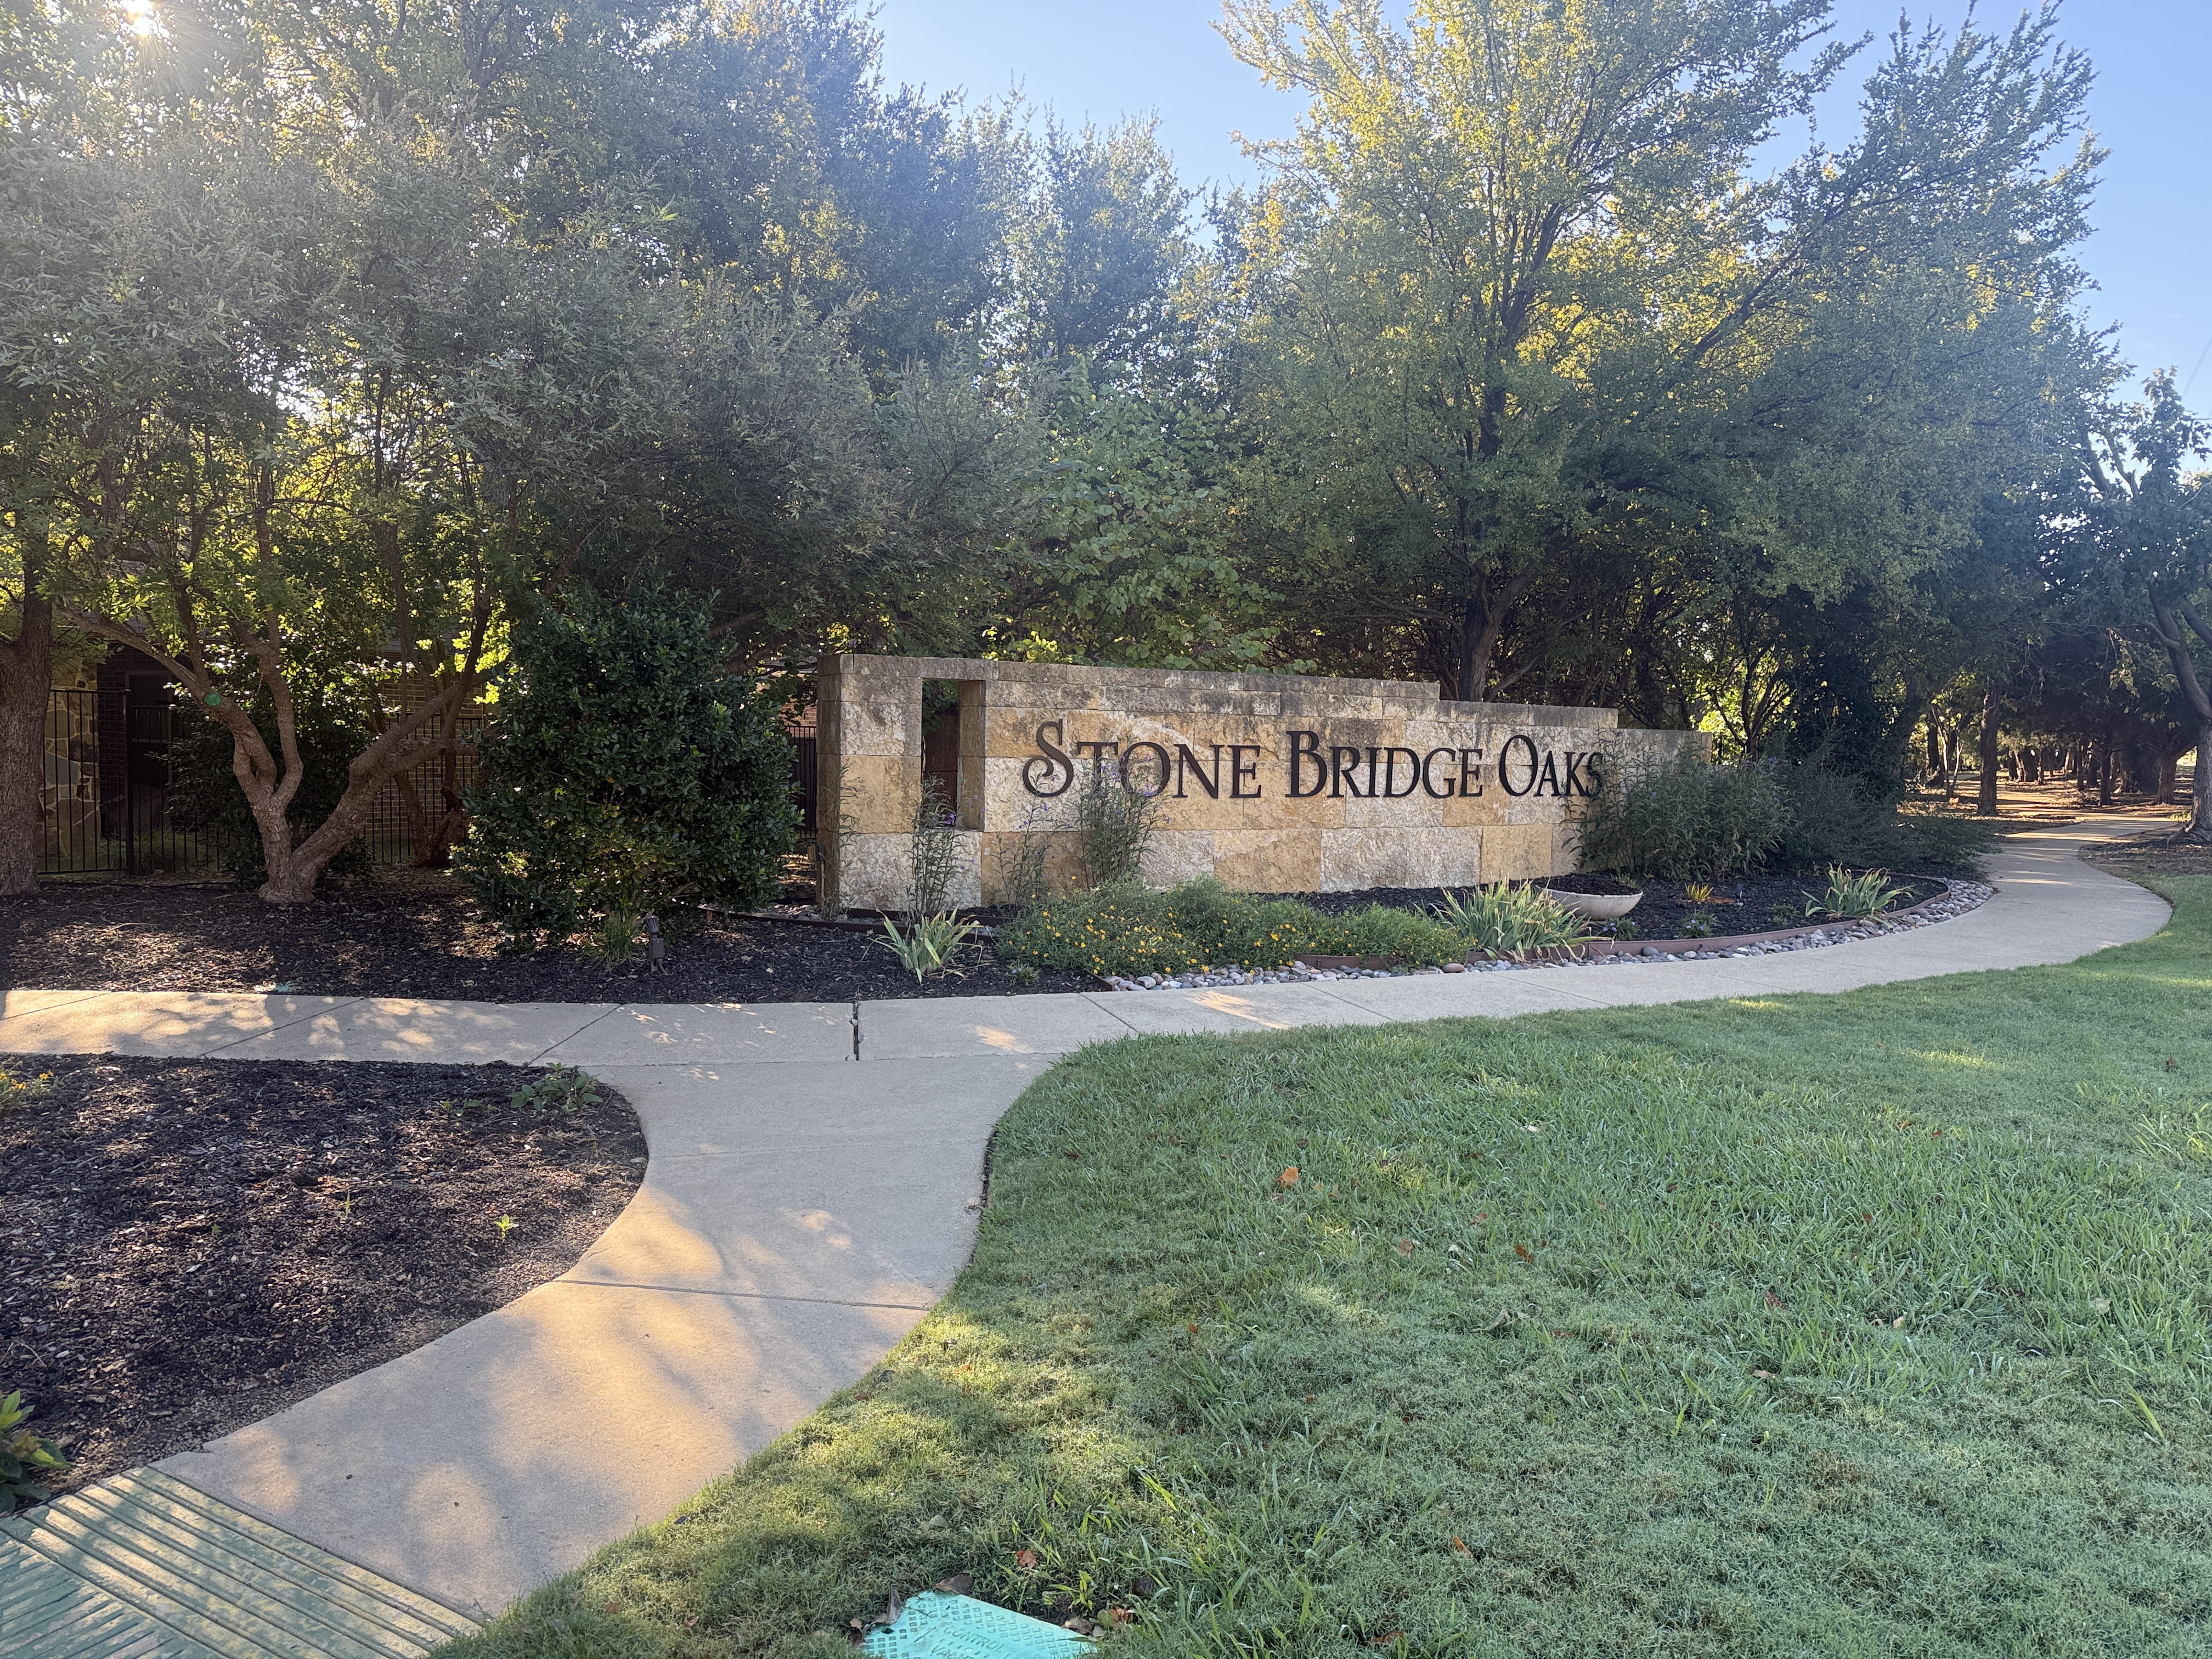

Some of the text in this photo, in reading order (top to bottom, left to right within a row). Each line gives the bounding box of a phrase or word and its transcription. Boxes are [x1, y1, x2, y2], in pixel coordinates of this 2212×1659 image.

[1022, 718, 1603, 799] STONE BRIDGE OAKS
[943, 1626, 1005, 1653] CONTROL
